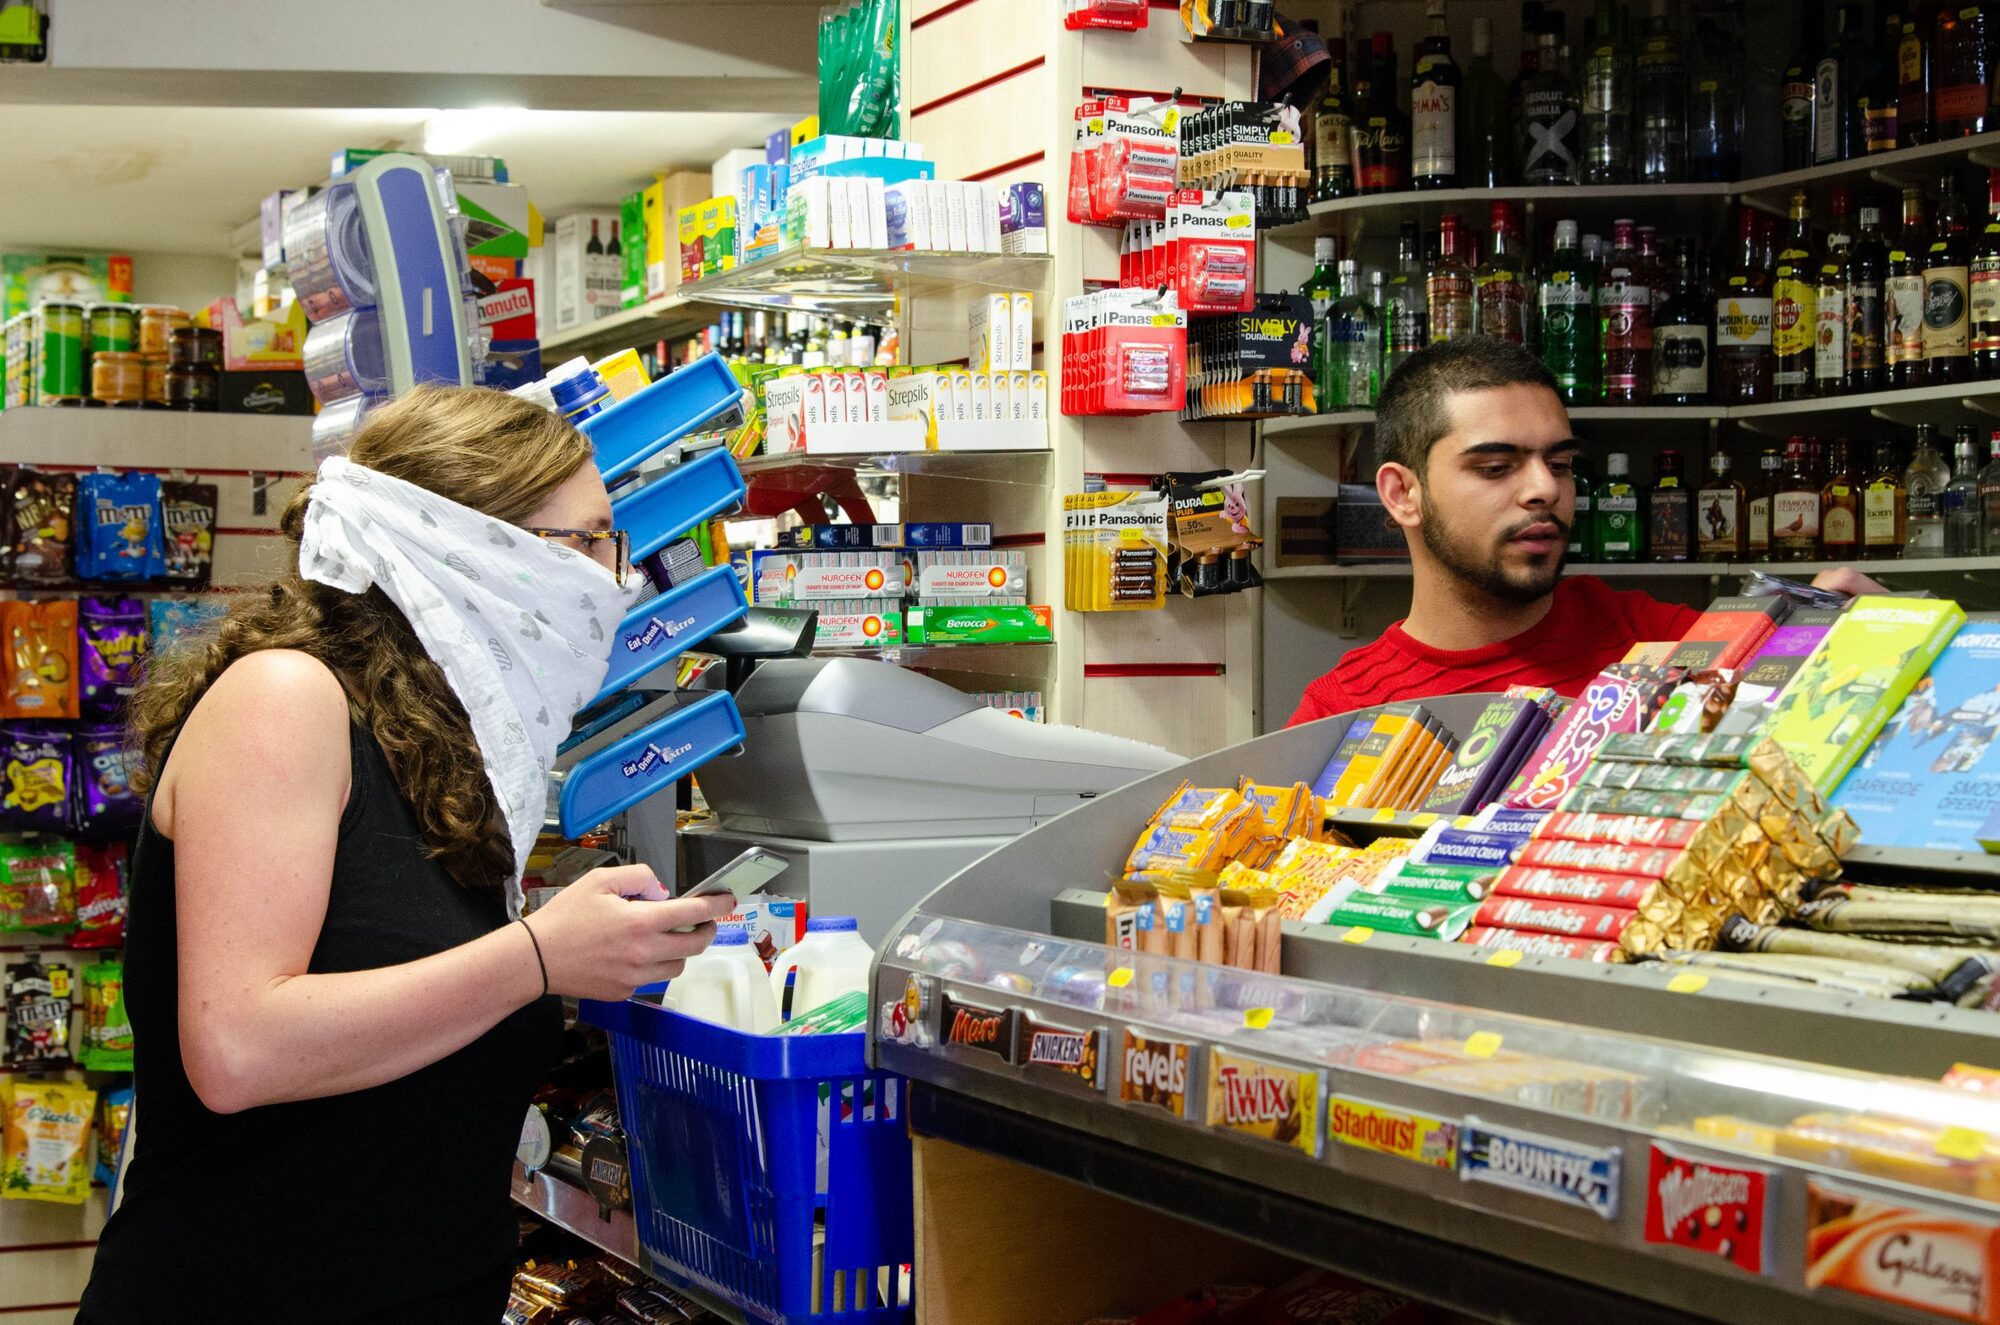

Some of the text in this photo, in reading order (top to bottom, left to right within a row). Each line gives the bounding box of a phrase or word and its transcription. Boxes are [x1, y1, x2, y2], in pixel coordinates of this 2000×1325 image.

[1232, 102, 1244, 110] AA
[1413, 94, 1450, 113] PIMM'S
[1107, 119, 1176, 139] Panasonic
[1232, 125, 1270, 136] SIMPLY
[1236, 135, 1270, 143] DURACELL
[1132, 153, 1169, 164] Panasonic
[1128, 191, 1165, 201] Panasonic
[1775, 301, 1804, 314] avana
[1109, 311, 1183, 326] Panasc
[1719, 314, 1770, 326] MOUNT GAY
[1775, 312, 1797, 325] Club
[1245, 333, 1283, 342] DURACELL
[1725, 325, 1743, 336] 1703
[995, 324, 1003, 363] Strepsils
[1016, 323, 1024, 363] Strepsils
[767, 385, 800, 411] Strepsils
[889, 384, 929, 407] Strepsils
[1782, 499, 1815, 507] FAMOUS
[1099, 512, 1164, 525] Panasonic
[1177, 507, 1194, 517] PLUS
[1187, 520, 1204, 530] 50%
[821, 574, 862, 582] NUROFEN
[946, 571, 985, 579] NUROFEN
[818, 616, 859, 626] NUROFEN
[946, 619, 987, 629] Berocca
[1848, 607, 1939, 625] MONTEZUMA'S
[627, 636, 642, 651] Eat
[642, 623, 660, 645] Drink
[665, 616, 696, 638] Extra
[623, 762, 638, 778] Eat
[638, 750, 656, 771] Drink
[661, 742, 693, 763] Extra
[1439, 761, 1485, 785] Ombar
[1432, 843, 1507, 861] CHOCOLATE CREAM
[1545, 840, 1638, 868] Munchies
[1434, 879, 1465, 891] CREAM
[1524, 868, 1607, 899] Munchies
[771, 906, 782, 915] 36
[1382, 905, 1413, 919] CREAM
[1504, 900, 1587, 932] Munchies
[1487, 928, 1576, 958] Munchies
[950, 1008, 1000, 1044] Mars
[1032, 1033, 1084, 1063] SNICKERS
[1126, 1047, 1185, 1094] revels
[1332, 1103, 1417, 1151] Starburst
[1488, 1137, 1581, 1190] BOUNTY
[591, 1158, 621, 1187] SNICKERS
[1876, 1231, 1982, 1315] Galaxy
